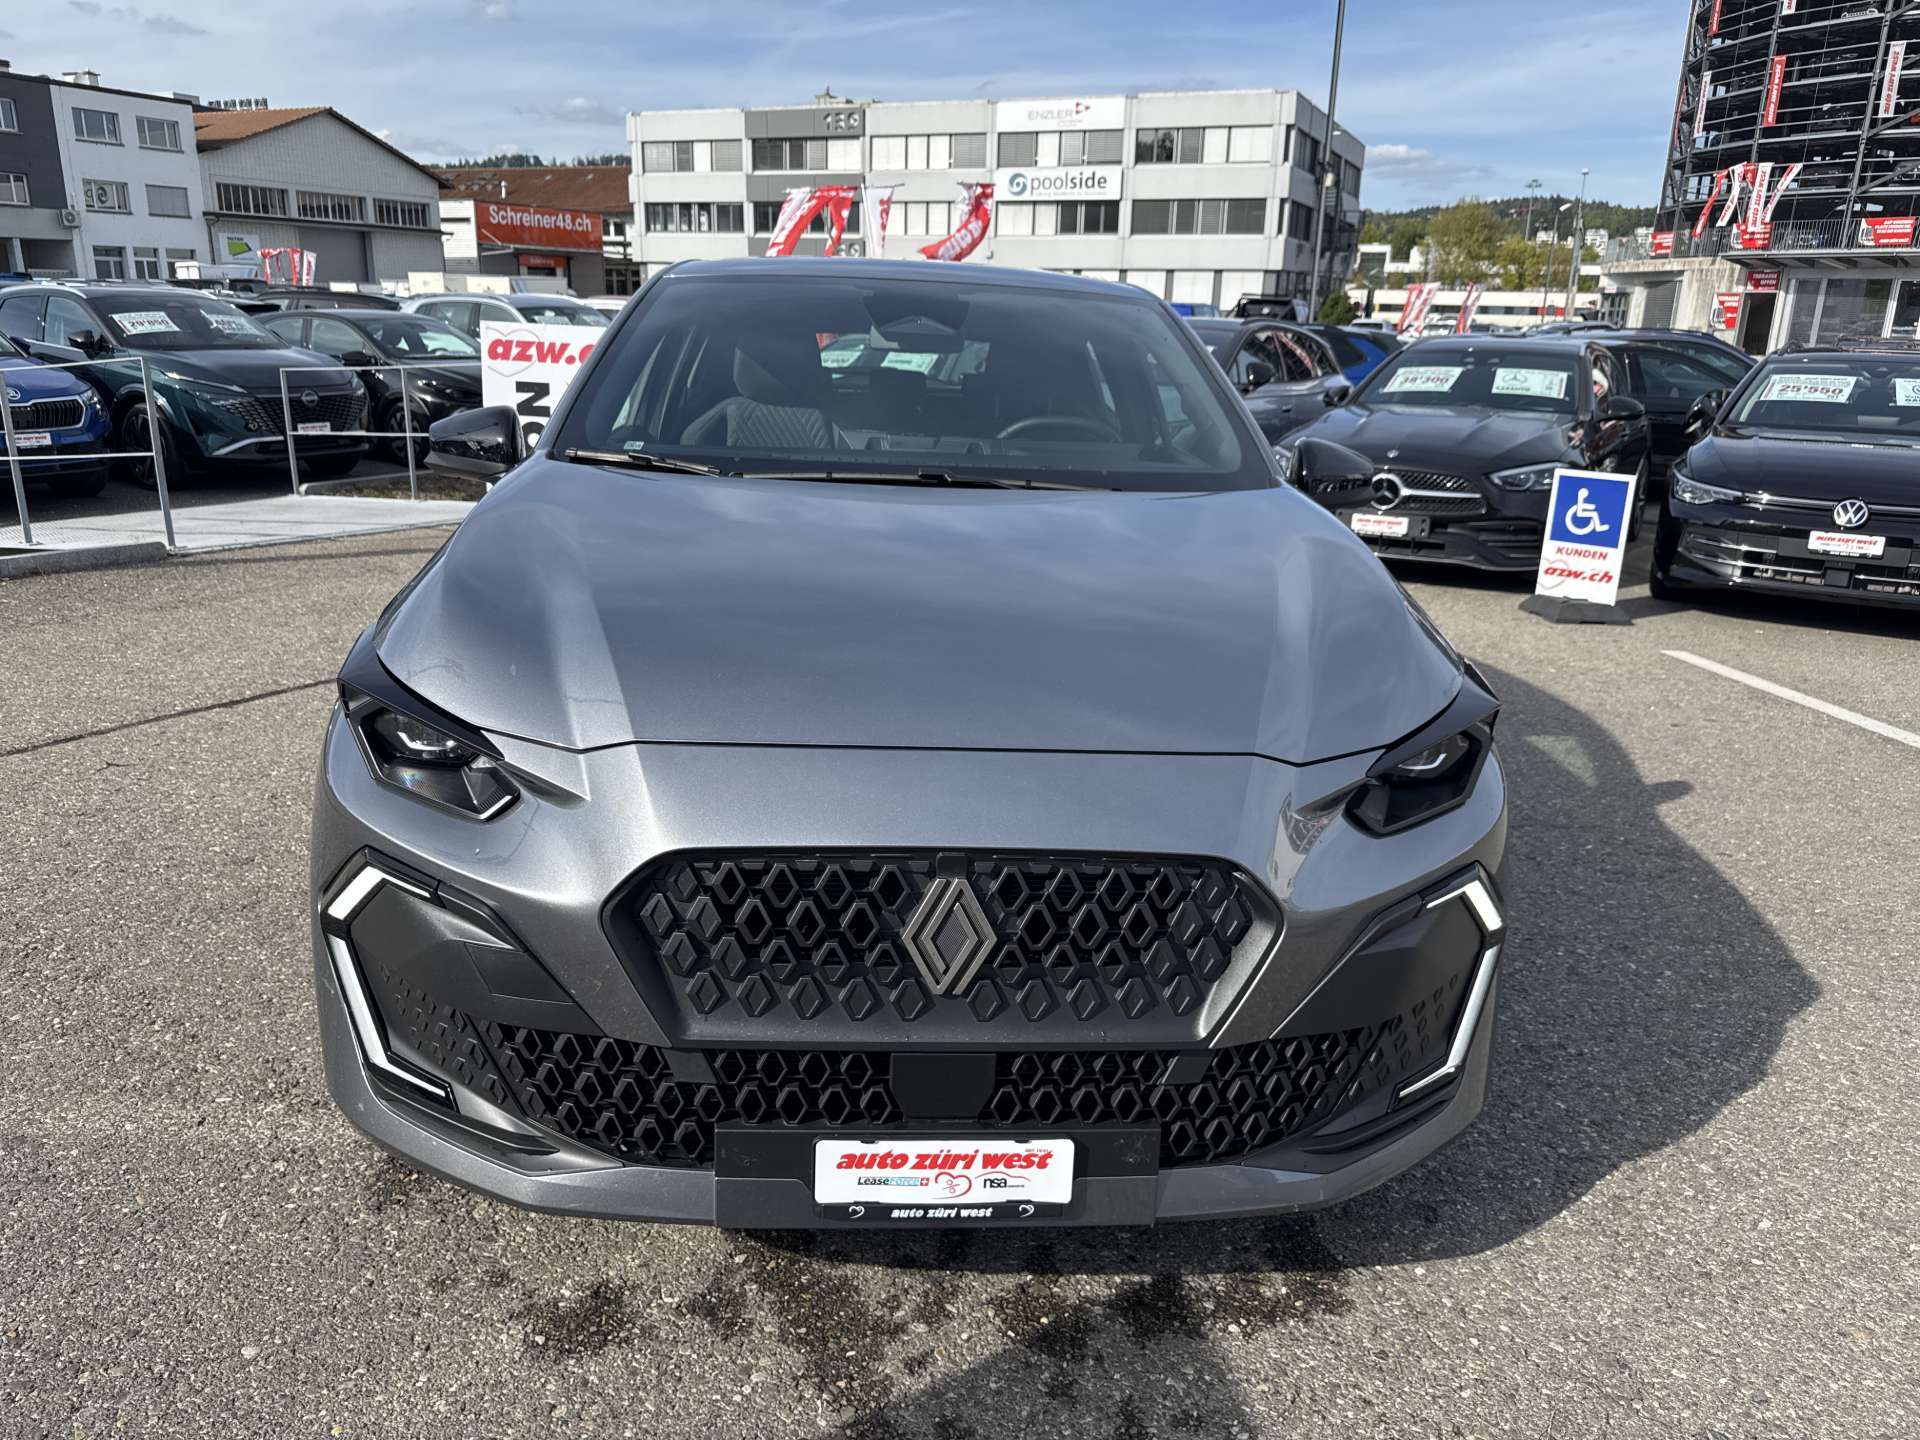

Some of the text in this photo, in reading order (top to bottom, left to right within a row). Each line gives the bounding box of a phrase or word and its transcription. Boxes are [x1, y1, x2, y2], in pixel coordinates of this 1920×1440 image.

[1028, 109, 1072, 120] ENZLER
[1031, 171, 1107, 196] poolside
[489, 205, 592, 232] Schreiner48.ch
[487, 338, 595, 365] azw.c
[1555, 546, 1609, 560] KUNDEN
[1544, 566, 1614, 584] azw.ch
[836, 1149, 1054, 1169] auto züri west
[983, 1176, 1007, 1188] nsa
[891, 1207, 993, 1218] auto züri west
